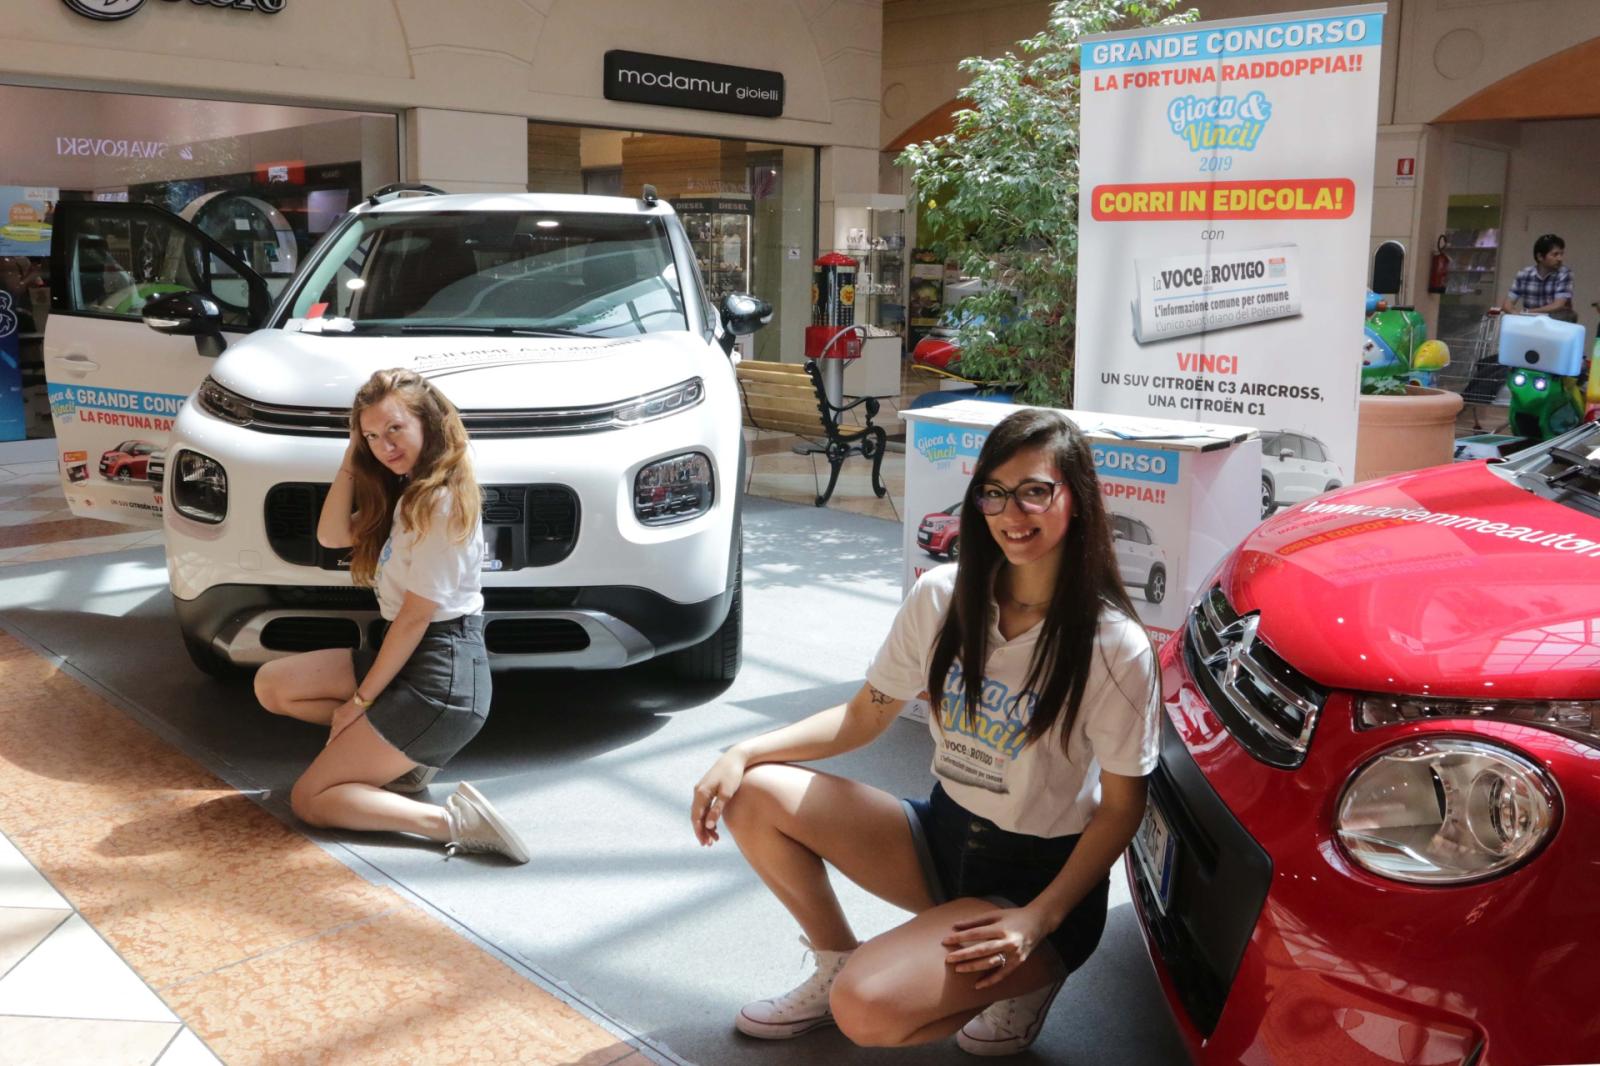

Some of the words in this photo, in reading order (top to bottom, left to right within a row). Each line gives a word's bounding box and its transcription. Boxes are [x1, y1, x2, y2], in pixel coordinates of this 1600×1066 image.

[1093, 35, 1199, 65] GRANDE
[1206, 18, 1367, 54] CONCORSO
[618, 66, 732, 96] modamur
[736, 85, 779, 102] gioielli
[1094, 71, 1118, 92] LA
[1123, 65, 1216, 90] FORTUNA
[1221, 54, 1363, 82] RADDOPPIA!!
[1169, 94, 1234, 130] Gioca
[1240, 91, 1270, 120] &
[1184, 124, 1260, 150] Vinci!
[1199, 155, 1233, 173] 2019
[675, 202, 704, 210] DIESEL
[718, 202, 749, 211] DIESEL
[1099, 191, 1175, 214] CORRI
[1180, 189, 1207, 212] IN
[1213, 187, 1344, 212] EDICOLA!
[1201, 229, 1225, 241] con
[1152, 276, 1162, 292] la
[1211, 260, 1265, 284] ROVIGO
[1154, 300, 1209, 318] L'informazione
[1210, 297, 1240, 311] comune
[1241, 295, 1255, 308] per
[1256, 290, 1290, 304] comune
[1252, 303, 1292, 318] Polesine
[1176, 352, 1239, 375] VINCI
[77, 388, 139, 410] GRANDE
[1100, 372, 1120, 385] UN
[1123, 374, 1149, 388] SUV
[1152, 375, 1215, 393] CITROËN
[1217, 381, 1237, 395] C3
[1240, 382, 1325, 403] AIRCROSS,
[1147, 394, 1177, 409] UNA
[1180, 395, 1244, 414] CITROËN
[1247, 403, 1267, 416] C1
[79, 410, 95, 424] LA
[97, 412, 152, 430] FORTUNA
[946, 432, 958, 445] &
[1093, 450, 1168, 476] CORSO
[1102, 483, 1167, 505] OPPIA!!
